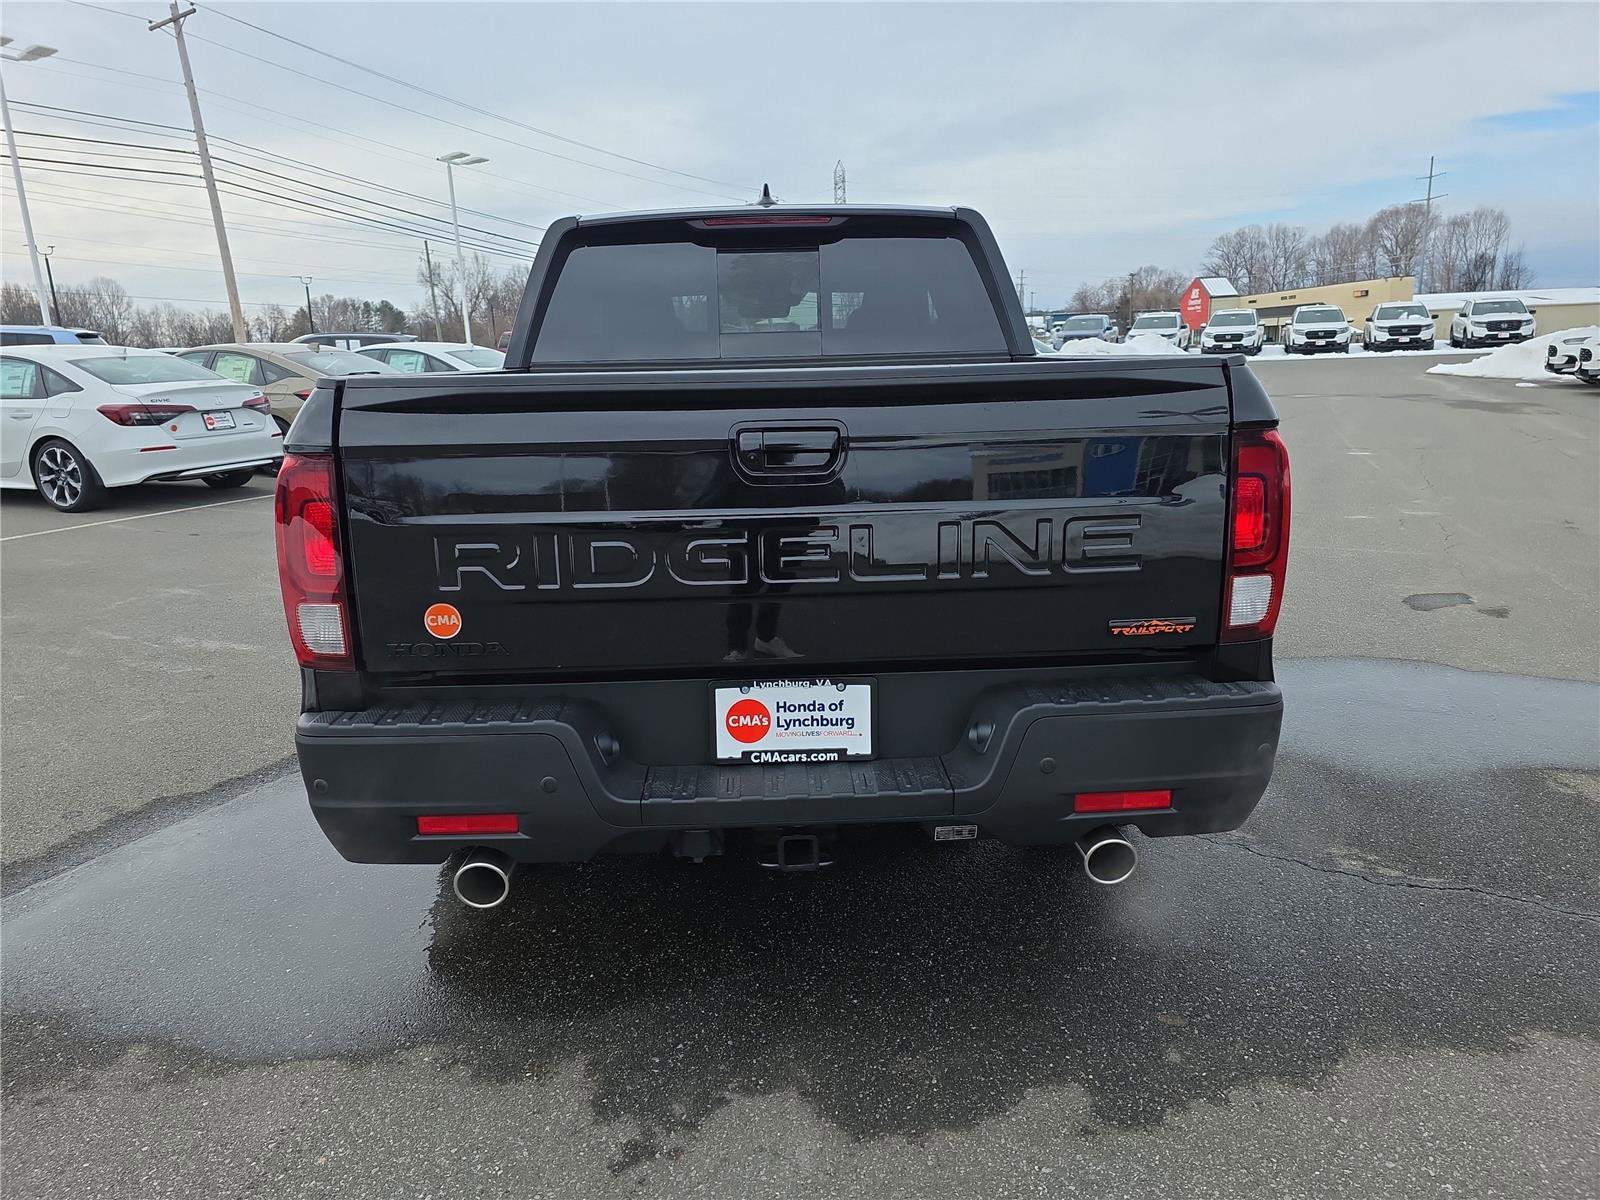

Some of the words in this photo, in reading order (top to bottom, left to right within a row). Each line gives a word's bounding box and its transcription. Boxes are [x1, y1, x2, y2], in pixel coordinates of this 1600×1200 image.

[433, 514, 1142, 591] RIDGELINE
[427, 615, 459, 627] CMA
[1111, 625, 1195, 636] TRAILSPORT
[386, 641, 510, 657] HONDA
[816, 679, 832, 687] VA
[776, 701, 825, 713] Honda
[828, 699, 844, 712] of
[728, 714, 769, 726] CMA's
[776, 715, 855, 730] Lynchburg
[750, 751, 838, 763] CMAcars.com
